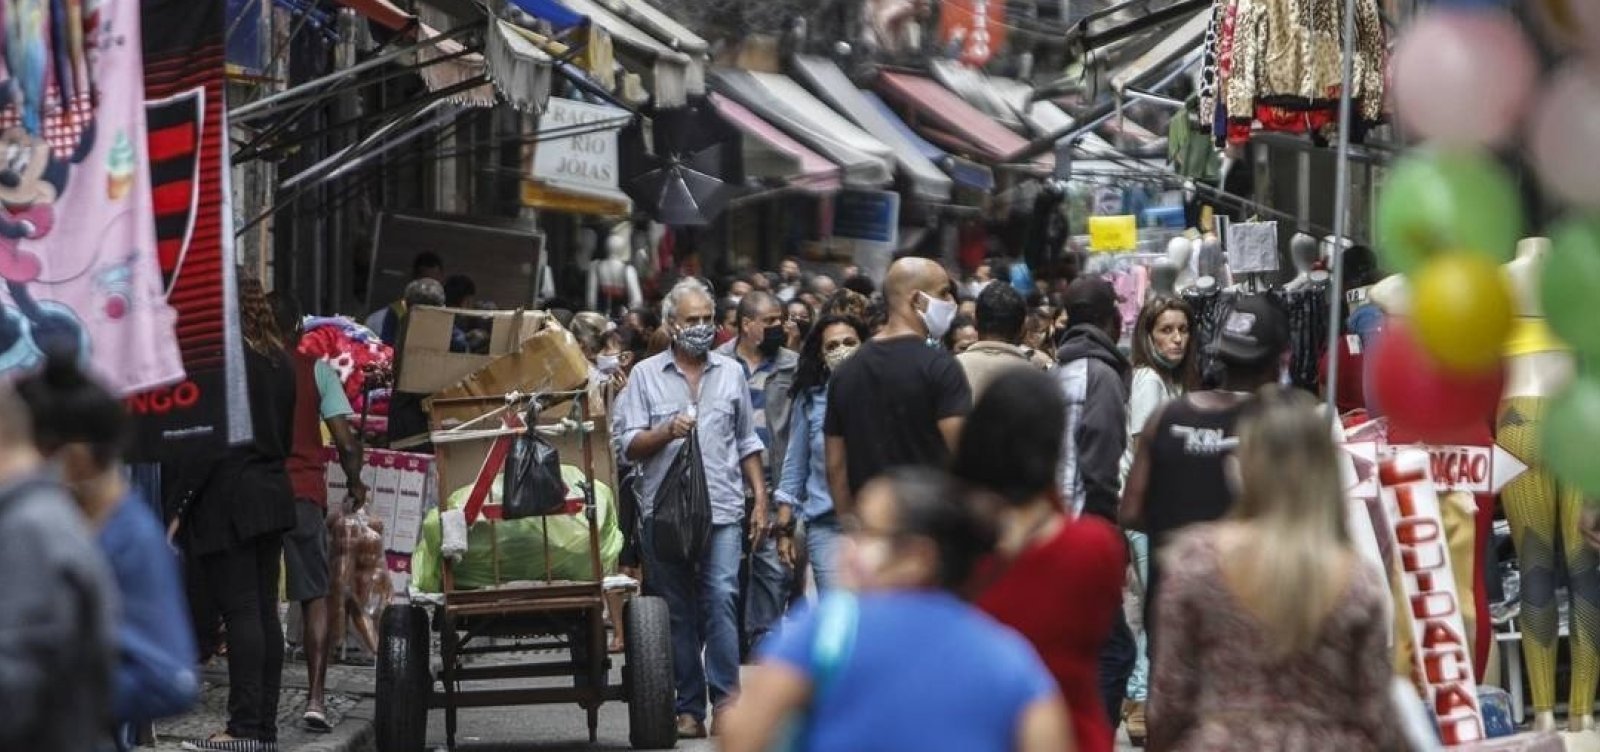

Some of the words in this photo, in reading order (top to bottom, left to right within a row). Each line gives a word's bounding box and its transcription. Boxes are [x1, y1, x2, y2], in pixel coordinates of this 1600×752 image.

[571, 135, 606, 154] RIO
[124, 381, 200, 414] NGO
[1429, 448, 1488, 486] NÇÃO
